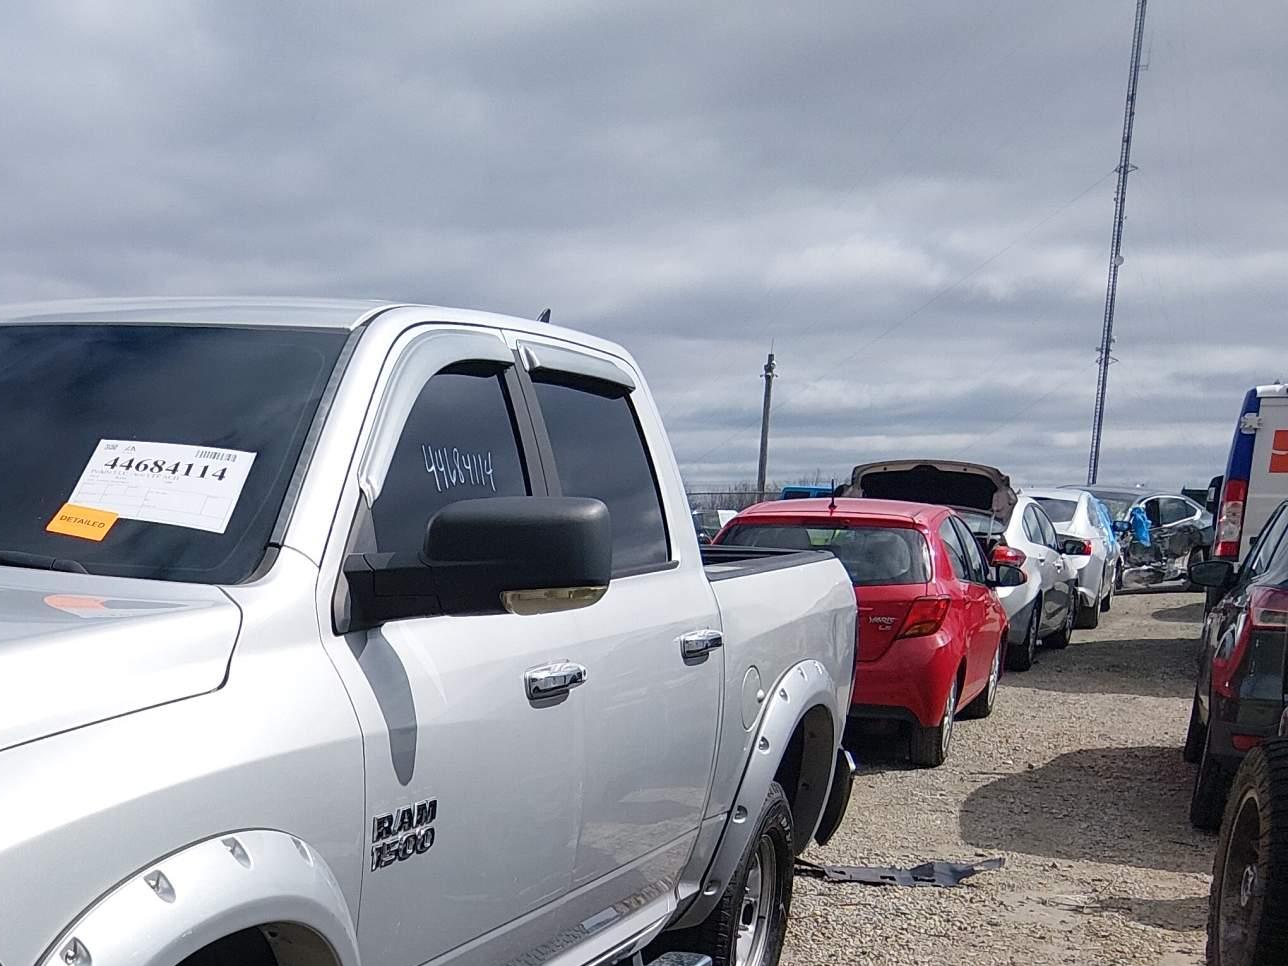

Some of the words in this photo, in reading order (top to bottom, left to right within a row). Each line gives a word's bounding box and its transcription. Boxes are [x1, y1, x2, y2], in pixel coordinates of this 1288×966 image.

[104, 456, 228, 481] 44684114
[422, 444, 496, 492] 44684114
[59, 514, 106, 529] DETAILED
[372, 798, 437, 843] RAM
[371, 826, 435, 872] 1500
